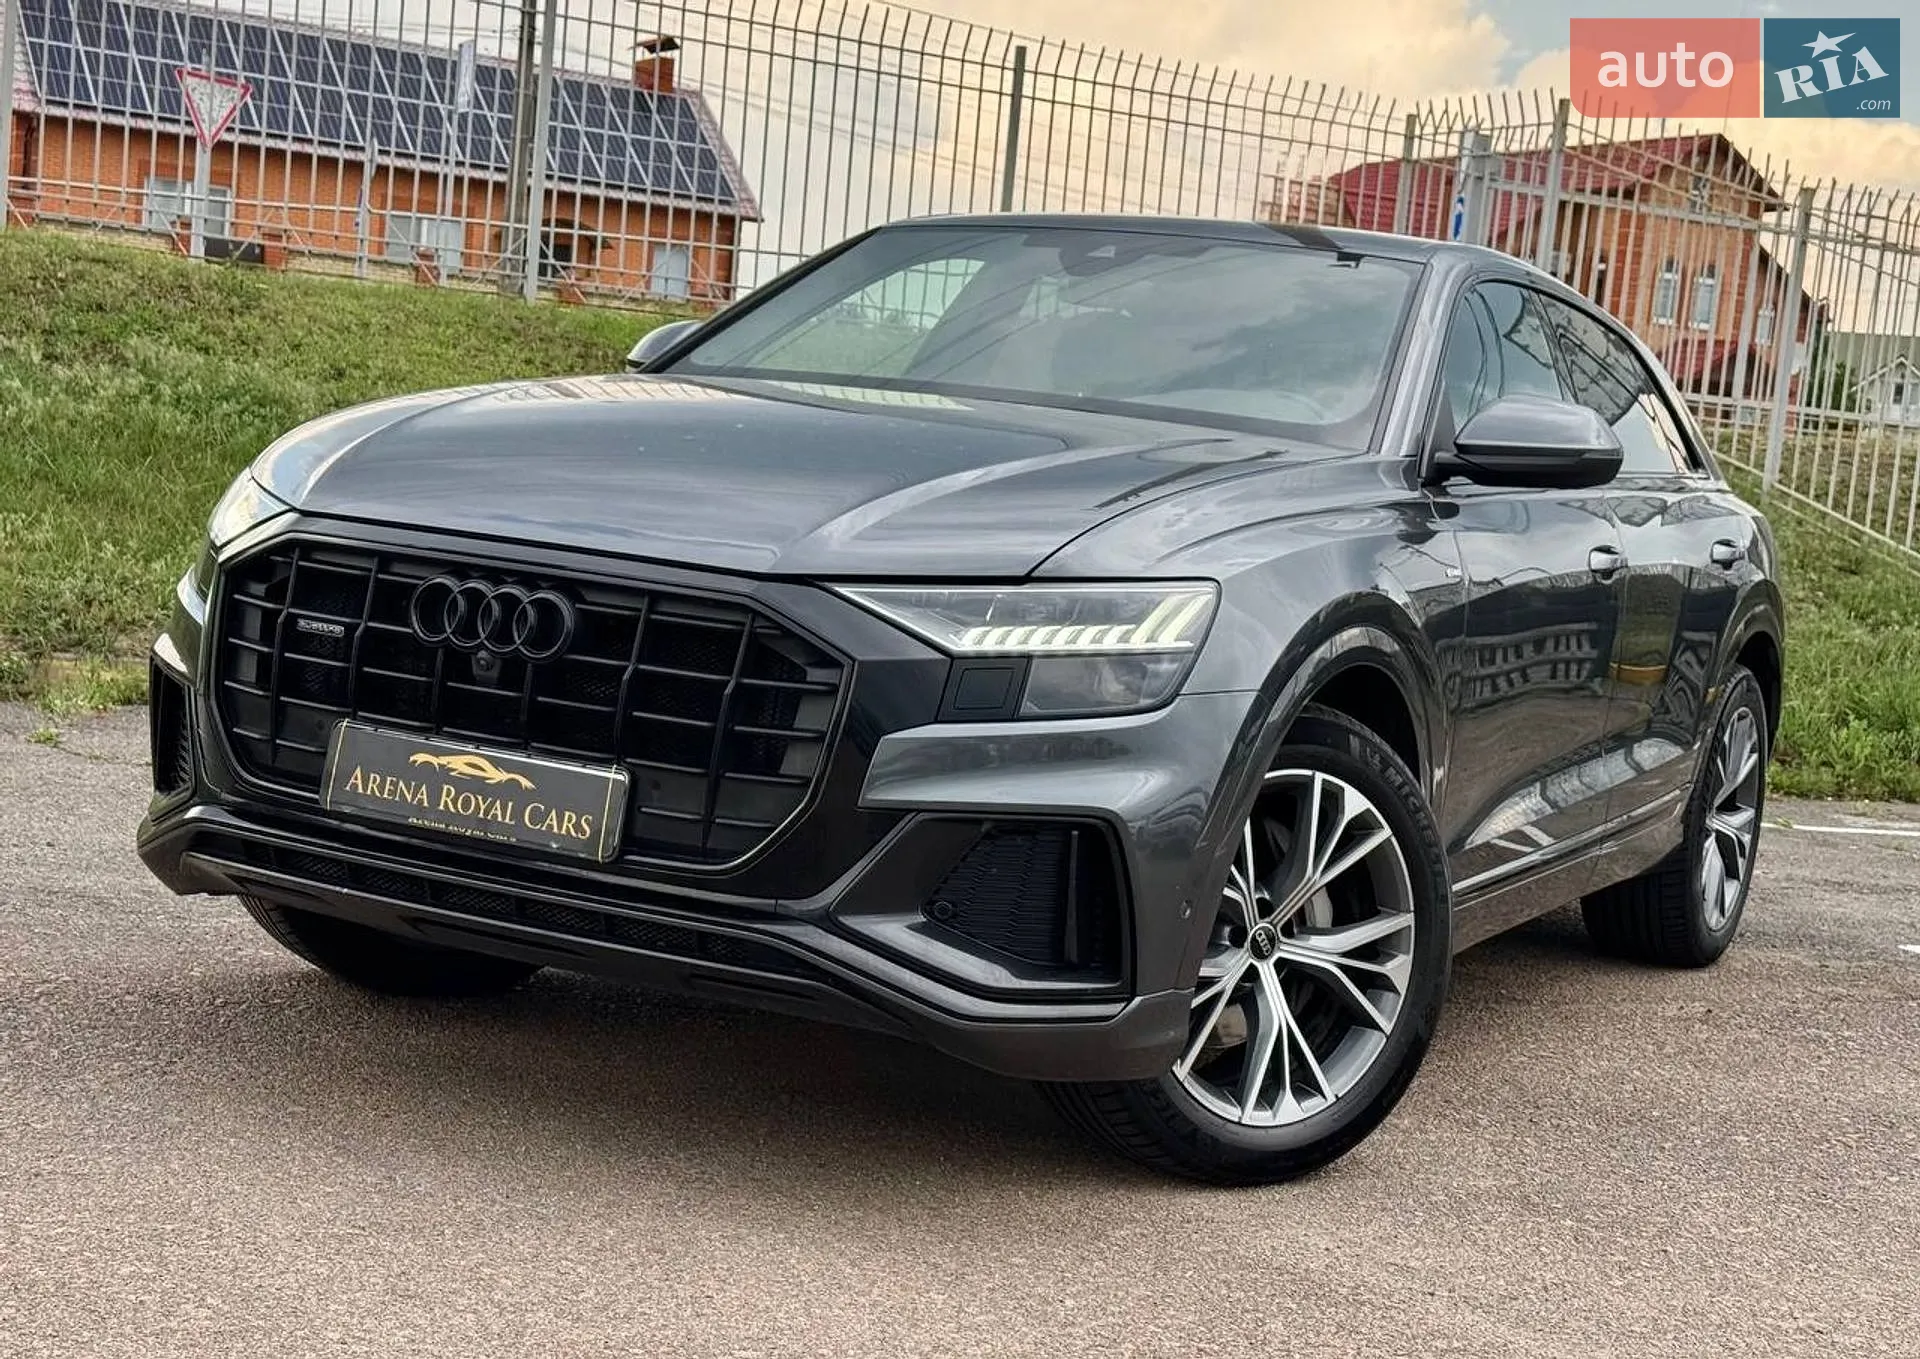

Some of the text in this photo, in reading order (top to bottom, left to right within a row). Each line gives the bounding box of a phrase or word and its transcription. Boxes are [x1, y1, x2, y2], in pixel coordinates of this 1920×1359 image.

[346, 765, 429, 808] ARENA
[439, 784, 516, 825] ROYAL
[524, 802, 592, 840] CARS
